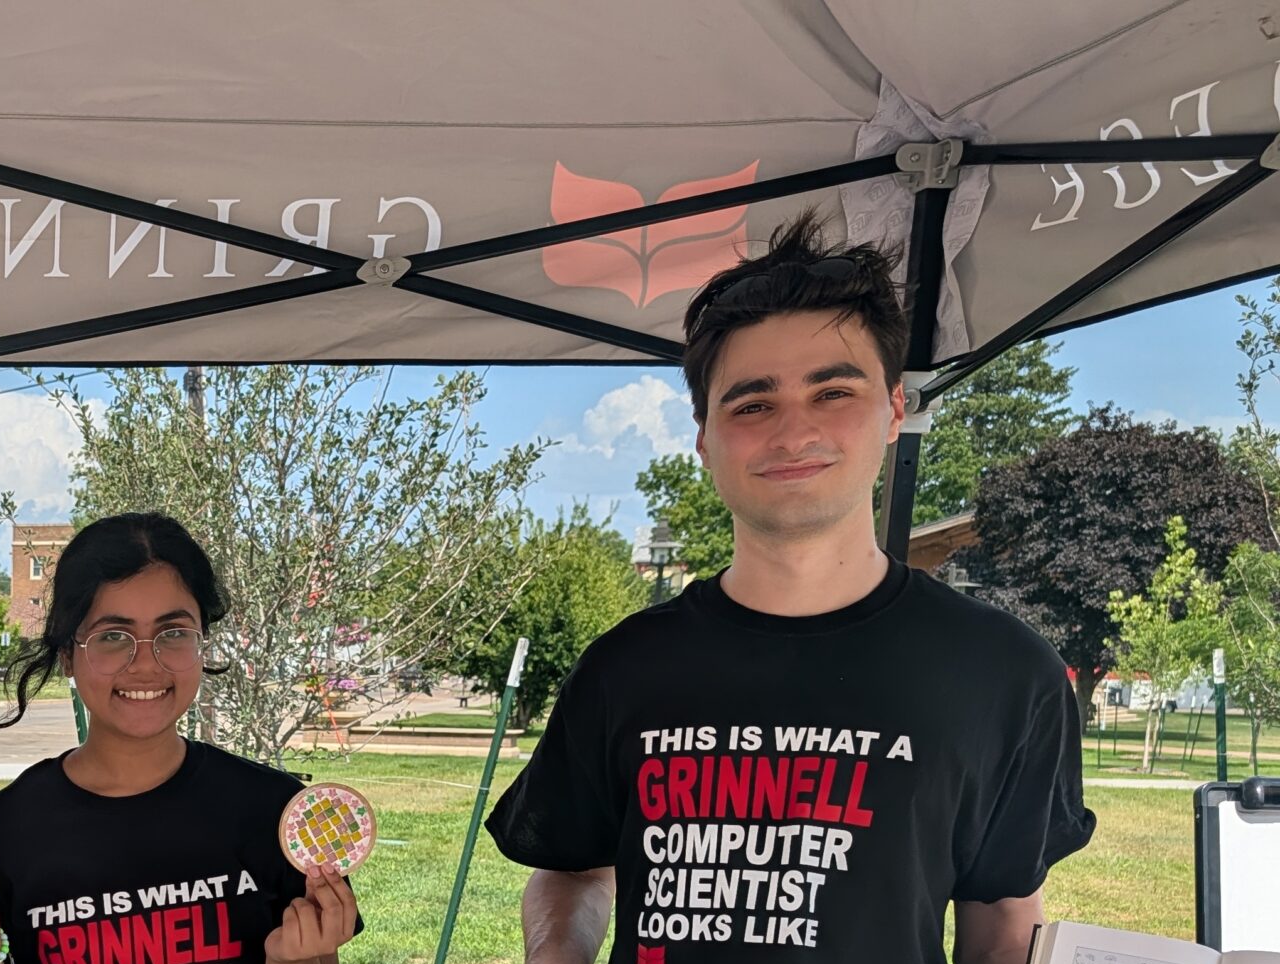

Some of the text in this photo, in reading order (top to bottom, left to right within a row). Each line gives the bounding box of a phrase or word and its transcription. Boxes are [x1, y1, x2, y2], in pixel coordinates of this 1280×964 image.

[640, 725, 913, 762] THIS IS WHAT A
[637, 755, 874, 828] GRINNELL
[643, 823, 853, 872] COMPUTER
[27, 870, 258, 929] THIS IS WHAT A
[644, 868, 826, 914] SCIENTIST
[637, 911, 819, 948] LOOKS LIKE
